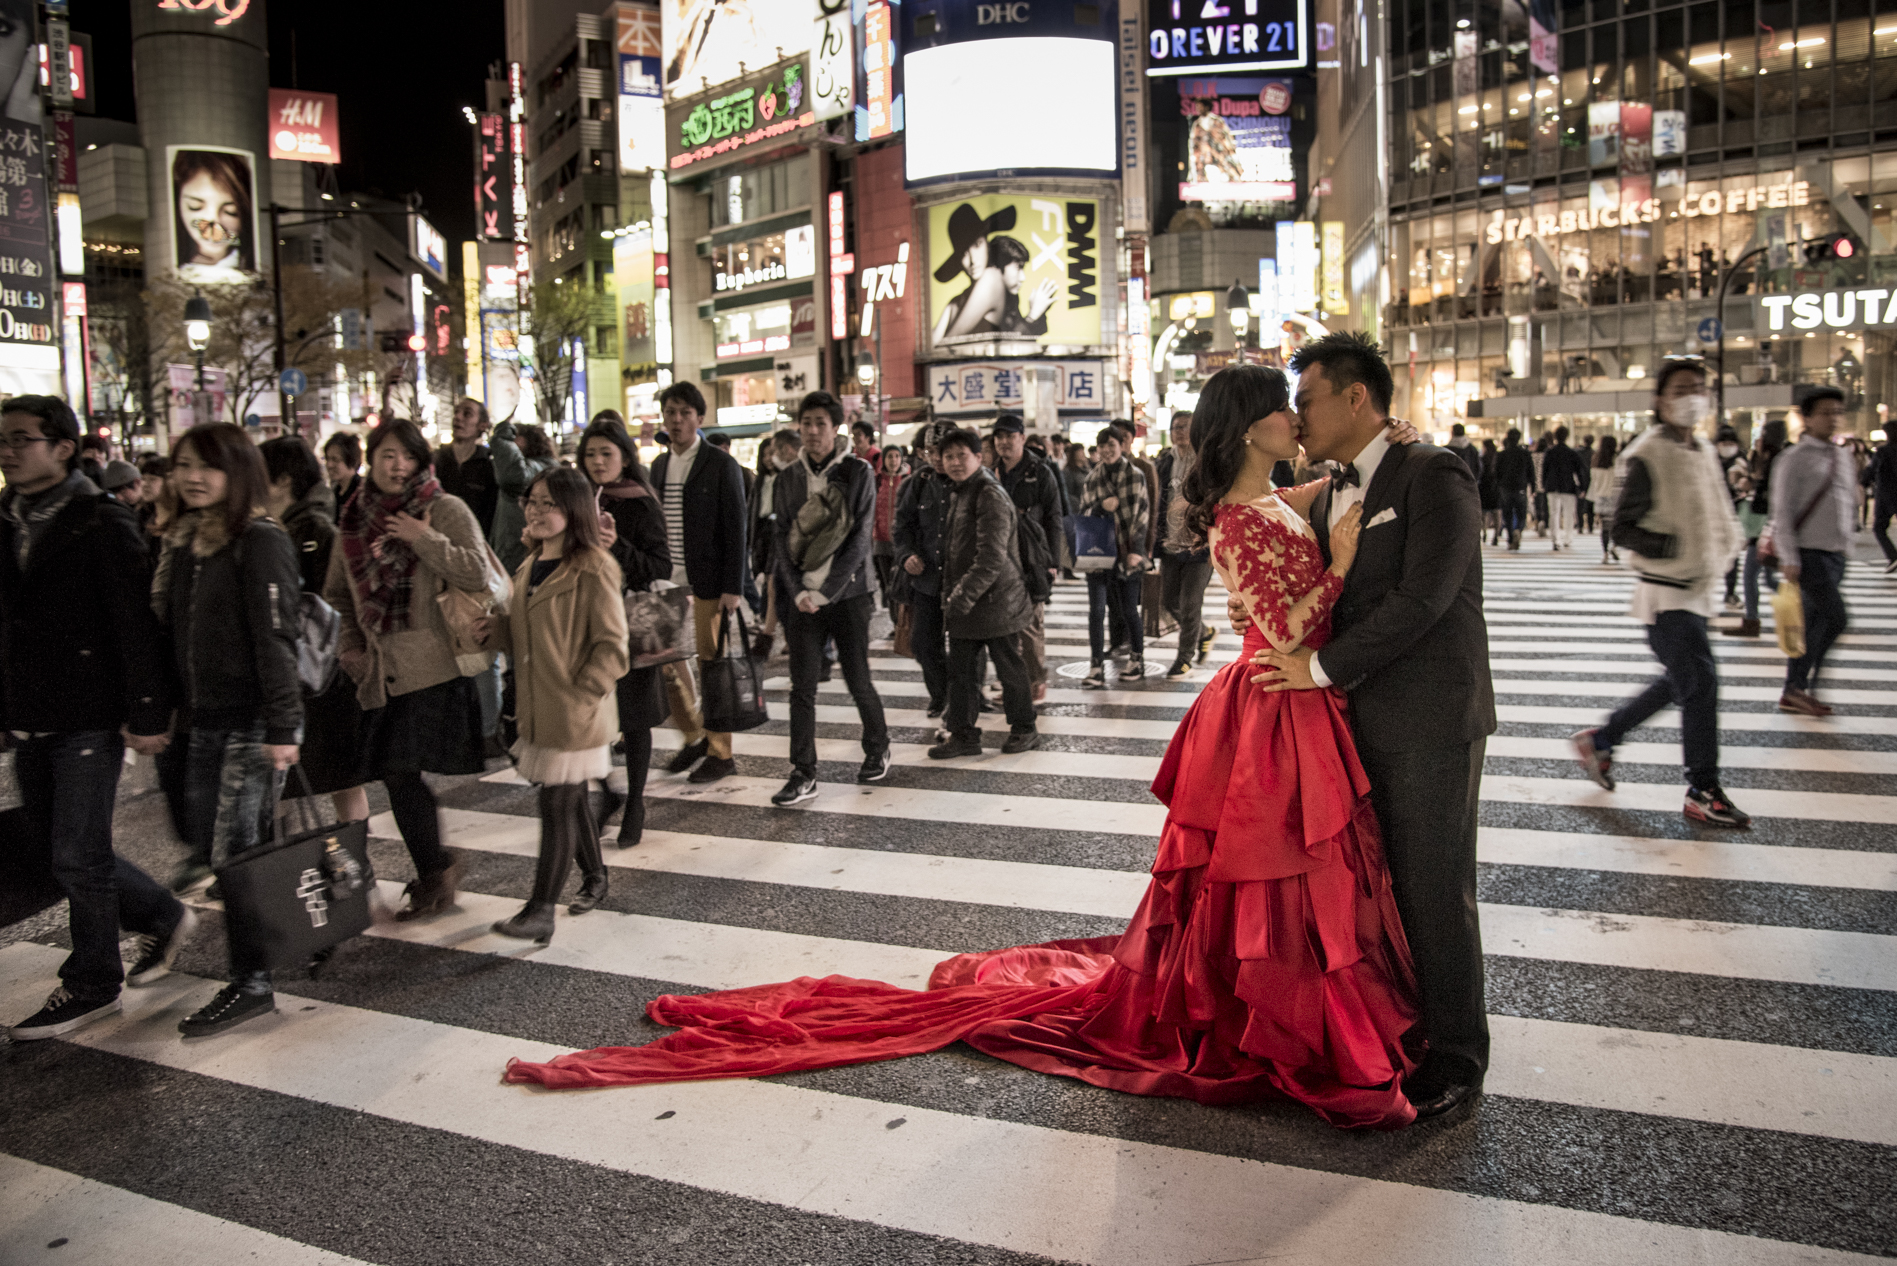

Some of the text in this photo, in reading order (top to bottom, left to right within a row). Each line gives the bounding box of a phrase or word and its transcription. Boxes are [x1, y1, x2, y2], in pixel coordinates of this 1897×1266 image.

[977, 2, 1030, 25] DHC
[1266, 21, 1296, 53] 21
[1122, 15, 1140, 169] Taisei neon
[1221, 98, 1261, 117] Dupa
[280, 98, 324, 129] H&M
[1487, 181, 1810, 245] STARBUCKS COFFEE
[1031, 199, 1064, 272] FX
[0, 256, 43, 278] 日(金)
[1066, 203, 1096, 309] DMM
[716, 262, 786, 291] Euphoria
[0, 280, 45, 310] 日(土)
[938, 370, 1093, 402] 大盛堂店
